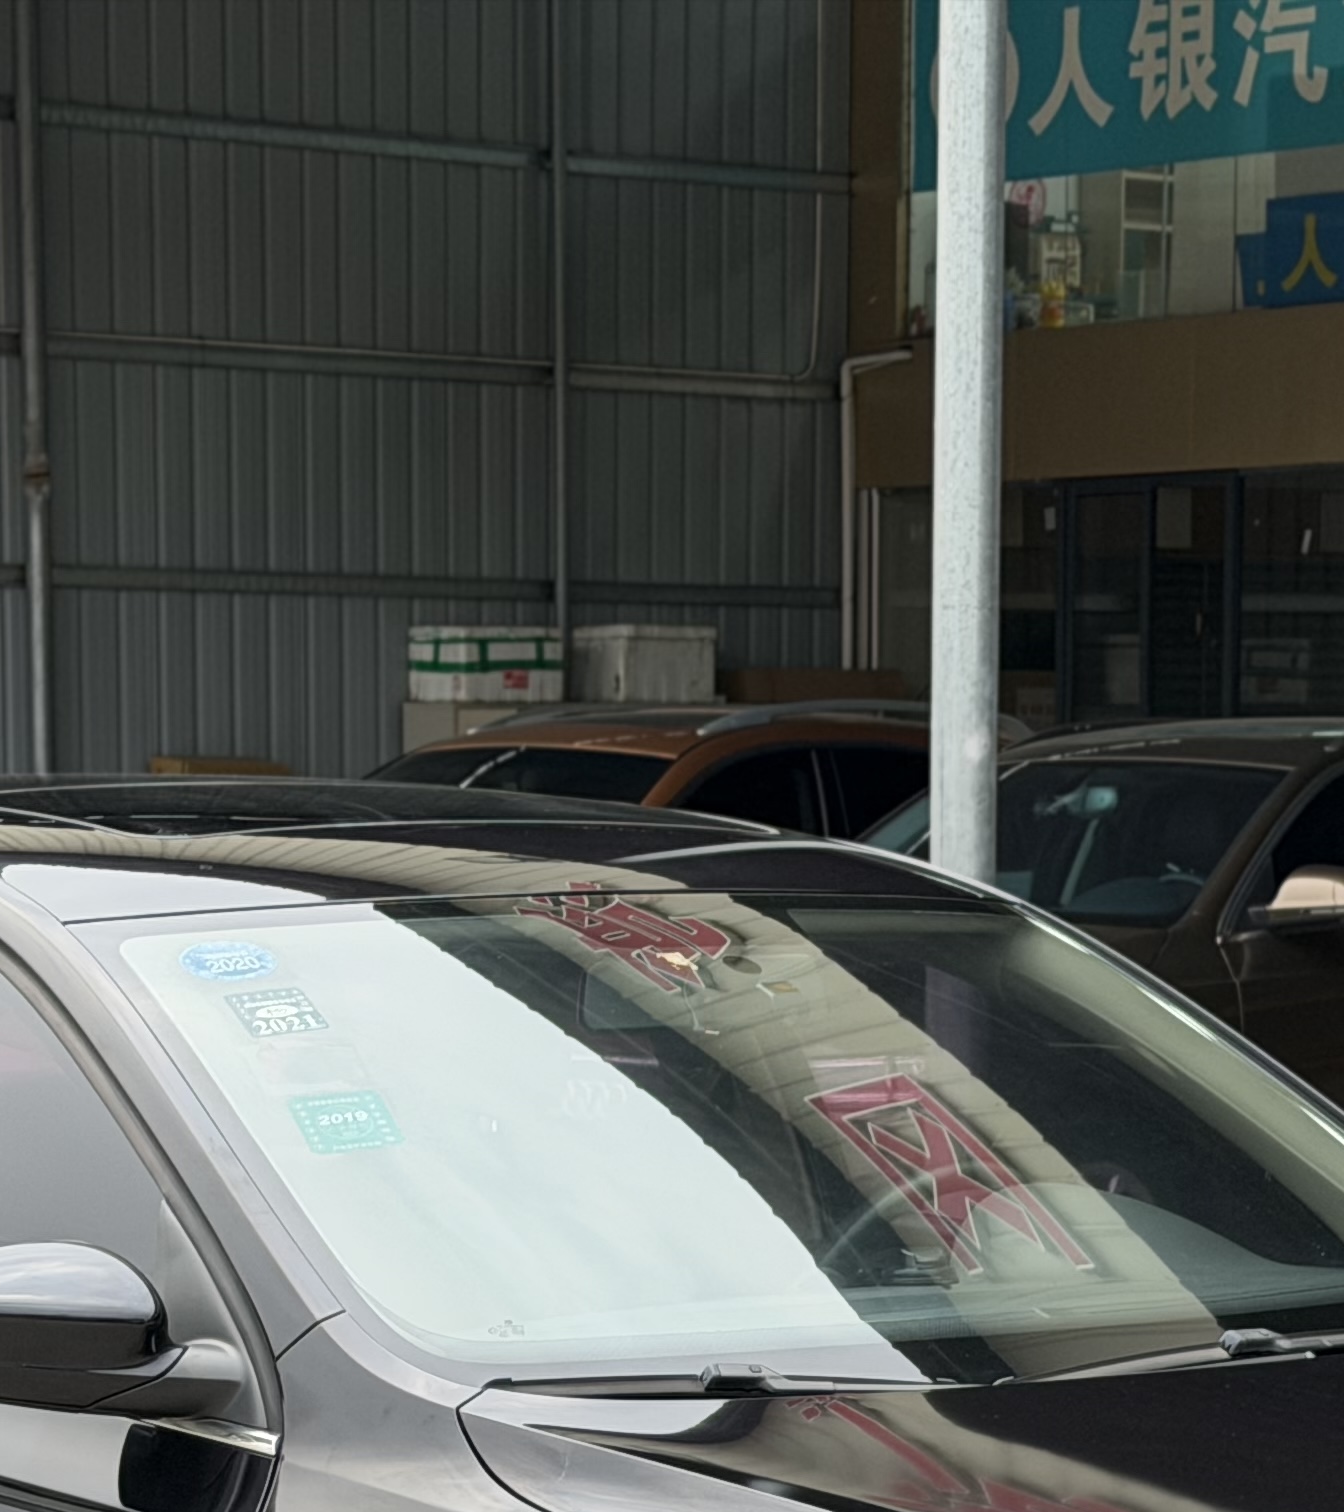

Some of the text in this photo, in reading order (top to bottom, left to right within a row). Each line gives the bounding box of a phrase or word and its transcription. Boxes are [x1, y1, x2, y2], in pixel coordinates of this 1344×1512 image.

[206, 955, 261, 975] 2020
[252, 1014, 321, 1035] 2021
[317, 1109, 369, 1127] 2019
